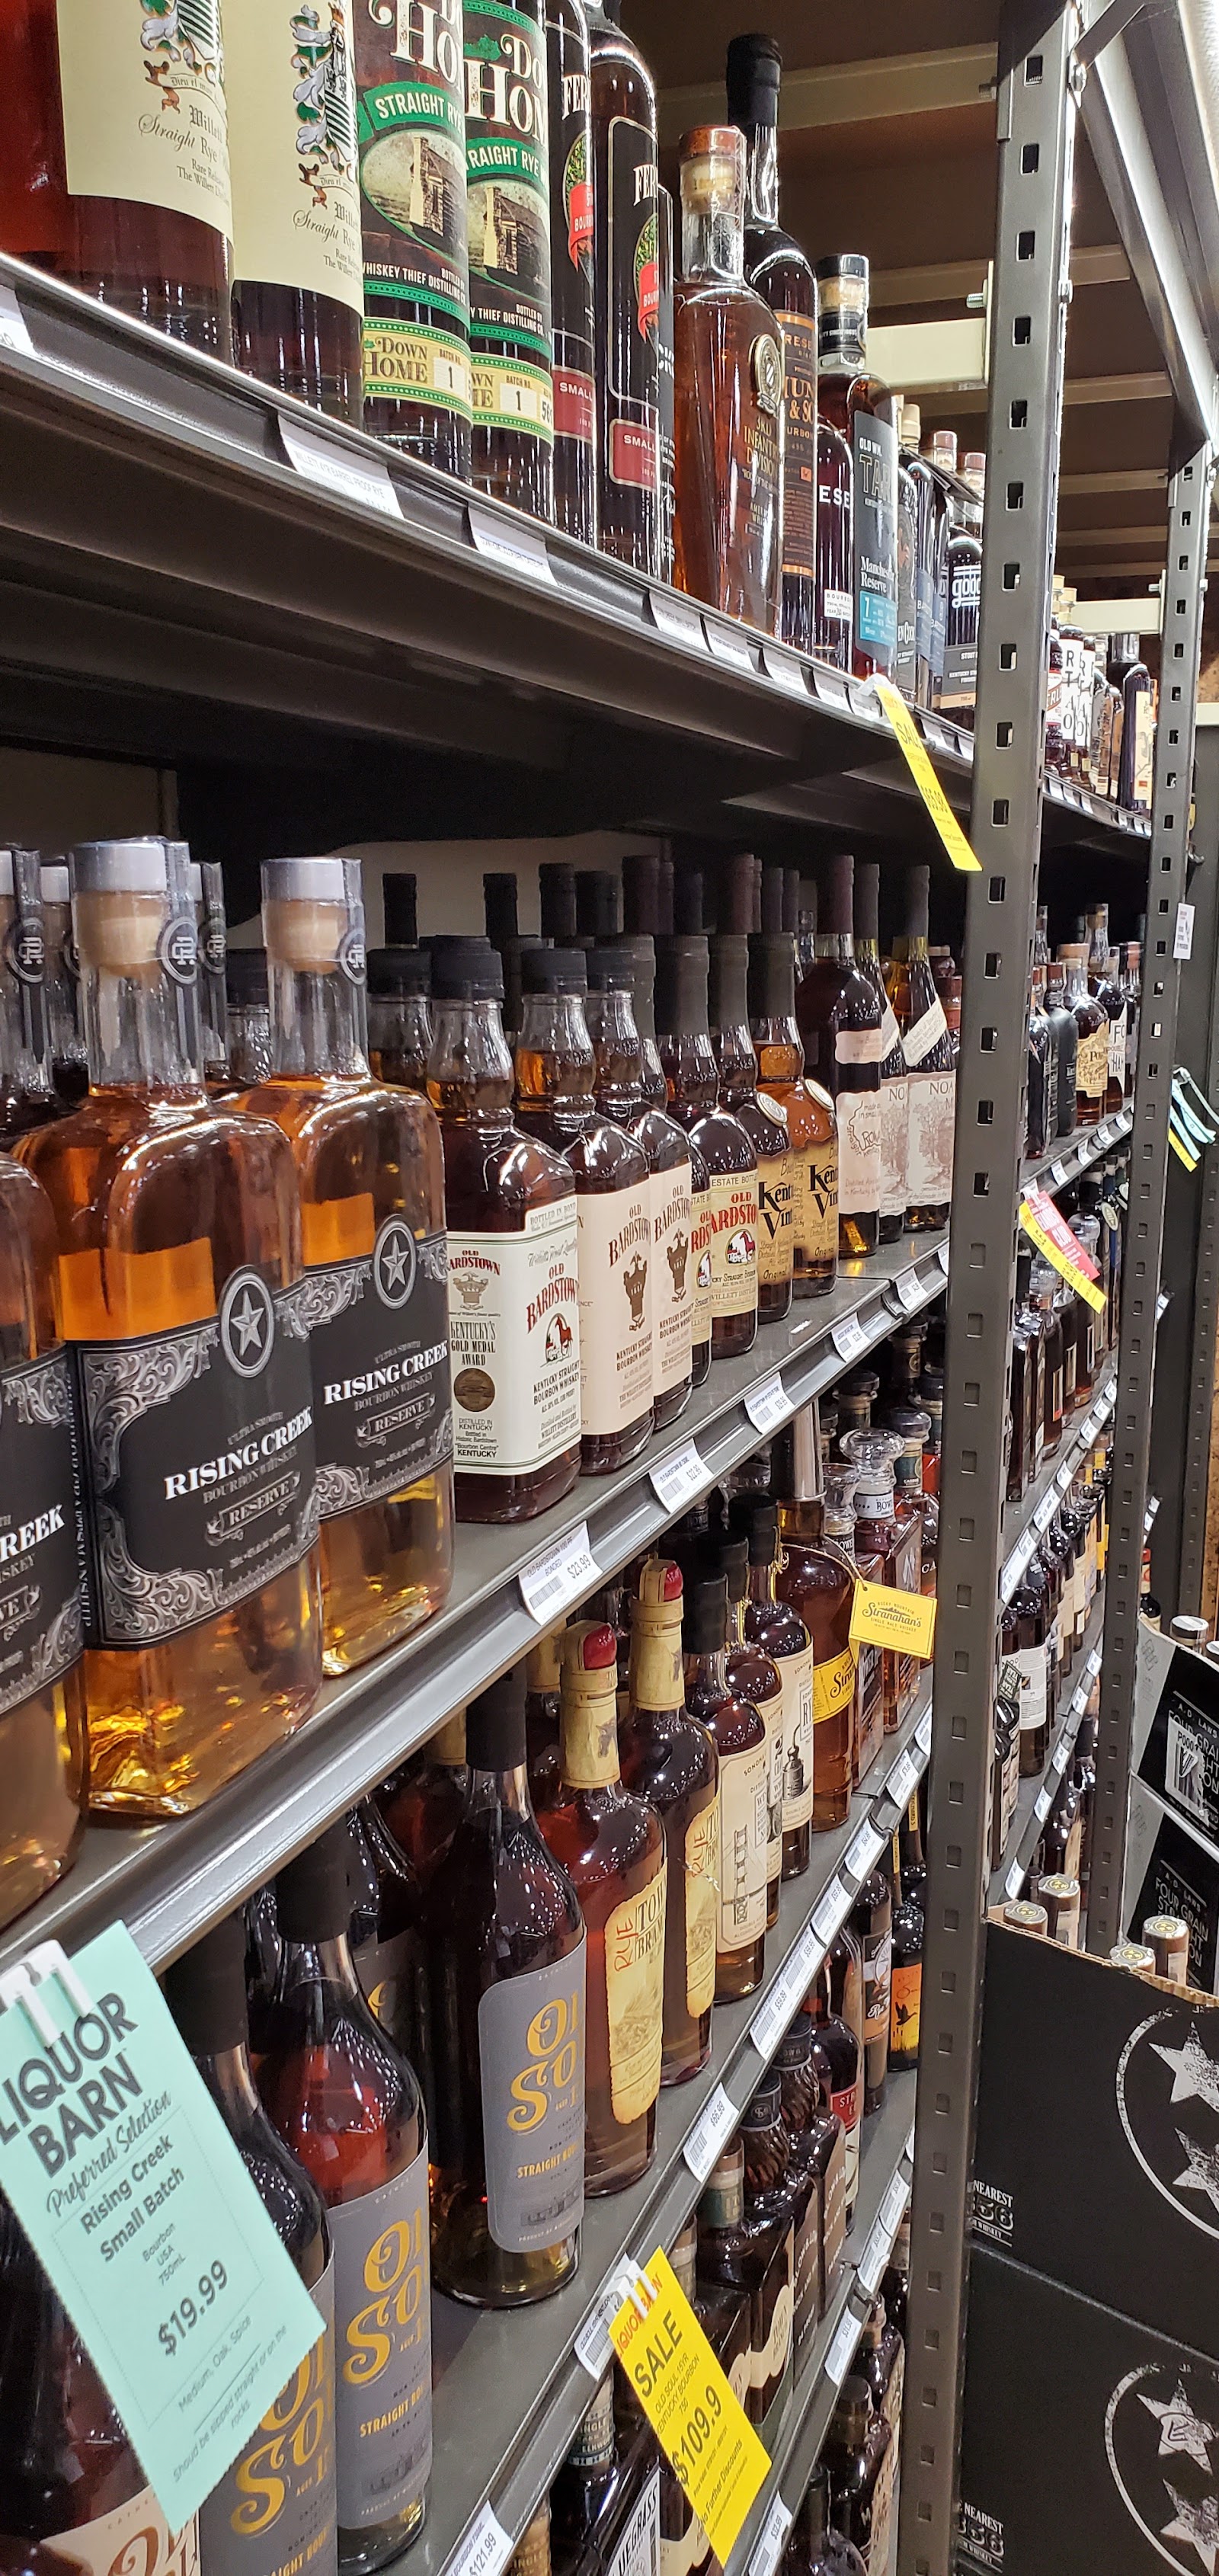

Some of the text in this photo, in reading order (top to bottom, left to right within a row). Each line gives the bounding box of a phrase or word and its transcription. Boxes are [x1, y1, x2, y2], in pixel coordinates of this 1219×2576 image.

[189, 104, 223, 144] Willett
[375, 91, 464, 133] STRAIGHT RYE
[139, 114, 218, 163] Straight Rye
[176, 165, 193, 182] The
[521, 149, 539, 177] RYE
[293, 210, 355, 251] Straight Rye
[323, 254, 336, 270] The
[402, 267, 427, 286] THIEF
[428, 274, 461, 301] DISTILLING
[478, 306, 501, 323] THIEF
[503, 312, 536, 334] DISTILLING
[376, 336, 427, 361] DOWN
[439, 348, 455, 360] BATCH
[448, 365, 454, 389] 1
[506, 374, 523, 387] BATCH
[515, 390, 522, 412] 1
[559, 382, 592, 402] SMALL
[756, 416, 773, 437] 3RD
[623, 434, 655, 453] SMALL
[859, 437, 871, 452] OLD
[860, 571, 888, 594] Reserve
[672, 1185, 684, 1198] OLD
[712, 1178, 739, 1187] ESTATE
[629, 1204, 641, 1218] OLD
[731, 1192, 751, 1204] OLD
[530, 1206, 562, 1225] BOTTLED IN
[448, 1256, 501, 1277] ARDSTOWN
[549, 1262, 565, 1280] OLD
[763, 1269, 788, 1280] Original
[450, 1320, 496, 1340] KENTUCKY'S
[659, 1314, 680, 1329] KENTUCKY
[659, 1324, 680, 1339] BOURBON
[451, 1340, 496, 1353] GOLD MEDAL
[461, 1353, 485, 1366] AWARD
[616, 1343, 638, 1361] KENTUCKY
[324, 1340, 449, 1405] RISING CREEK
[533, 1360, 580, 1394] KENTUCKY STRAIGHT
[616, 1355, 638, 1372] BOURBON
[354, 1371, 433, 1411] BOURBON WHISKEY
[533, 1372, 580, 1406] BOURBON WHISKEY
[375, 1400, 425, 1432] RESERVE
[541, 1423, 557, 1439] WILLETT
[164, 1441, 259, 1500] RISING
[261, 1406, 313, 1456] CREEK
[457, 1449, 497, 1458] KENTUCKY
[202, 1445, 298, 1506] BOURBON WHISKEY
[229, 1483, 290, 1526] RESERVE
[535, 1547, 561, 1571] BARDSTOWN
[545, 1558, 562, 1576] BONDED
[567, 1554, 591, 1579] $23.99
[862, 1602, 922, 1628] Stranahan's
[1198, 1717, 1218, 1739] LAWS
[1155, 1877, 1209, 1943] FOUR GRAIN
[1183, 1893, 1201, 1912] LAWS
[613, 1916, 640, 1973] RYE
[27, 2052, 143, 2178] BARN
[711, 2100, 725, 2128] $66.99
[46, 2090, 172, 2217] Preferred Selection
[516, 2150, 562, 2180] STRAIGHT
[80, 2133, 174, 2235] Rising Creek
[974, 2178, 1014, 2207] NEAREST
[100, 2166, 185, 2262] Small Batch
[142, 2222, 176, 2263] Bourbon
[157, 2245, 174, 2266] USA
[158, 2254, 187, 2286] 750mL
[158, 2260, 229, 2357] $19.99
[178, 2368, 215, 2414] Medium,
[230, 2315, 252, 2345] Spice
[634, 2309, 683, 2398] SALE
[199, 2432, 210, 2450] be
[210, 2398, 235, 2434] sipped
[234, 2362, 261, 2402] straight
[275, 2325, 287, 2343] the
[655, 2352, 689, 2414] OLD SOUL 15YR
[677, 2354, 700, 2395] BOURBON
[230, 2400, 251, 2430] rocks
[359, 2402, 410, 2438] STRAIGHT
[678, 2397, 689, 2416] 750
[672, 2385, 721, 2487] $109.9
[705, 2438, 743, 2514] Further Discounts
[964, 2501, 1003, 2535] NEAREST
